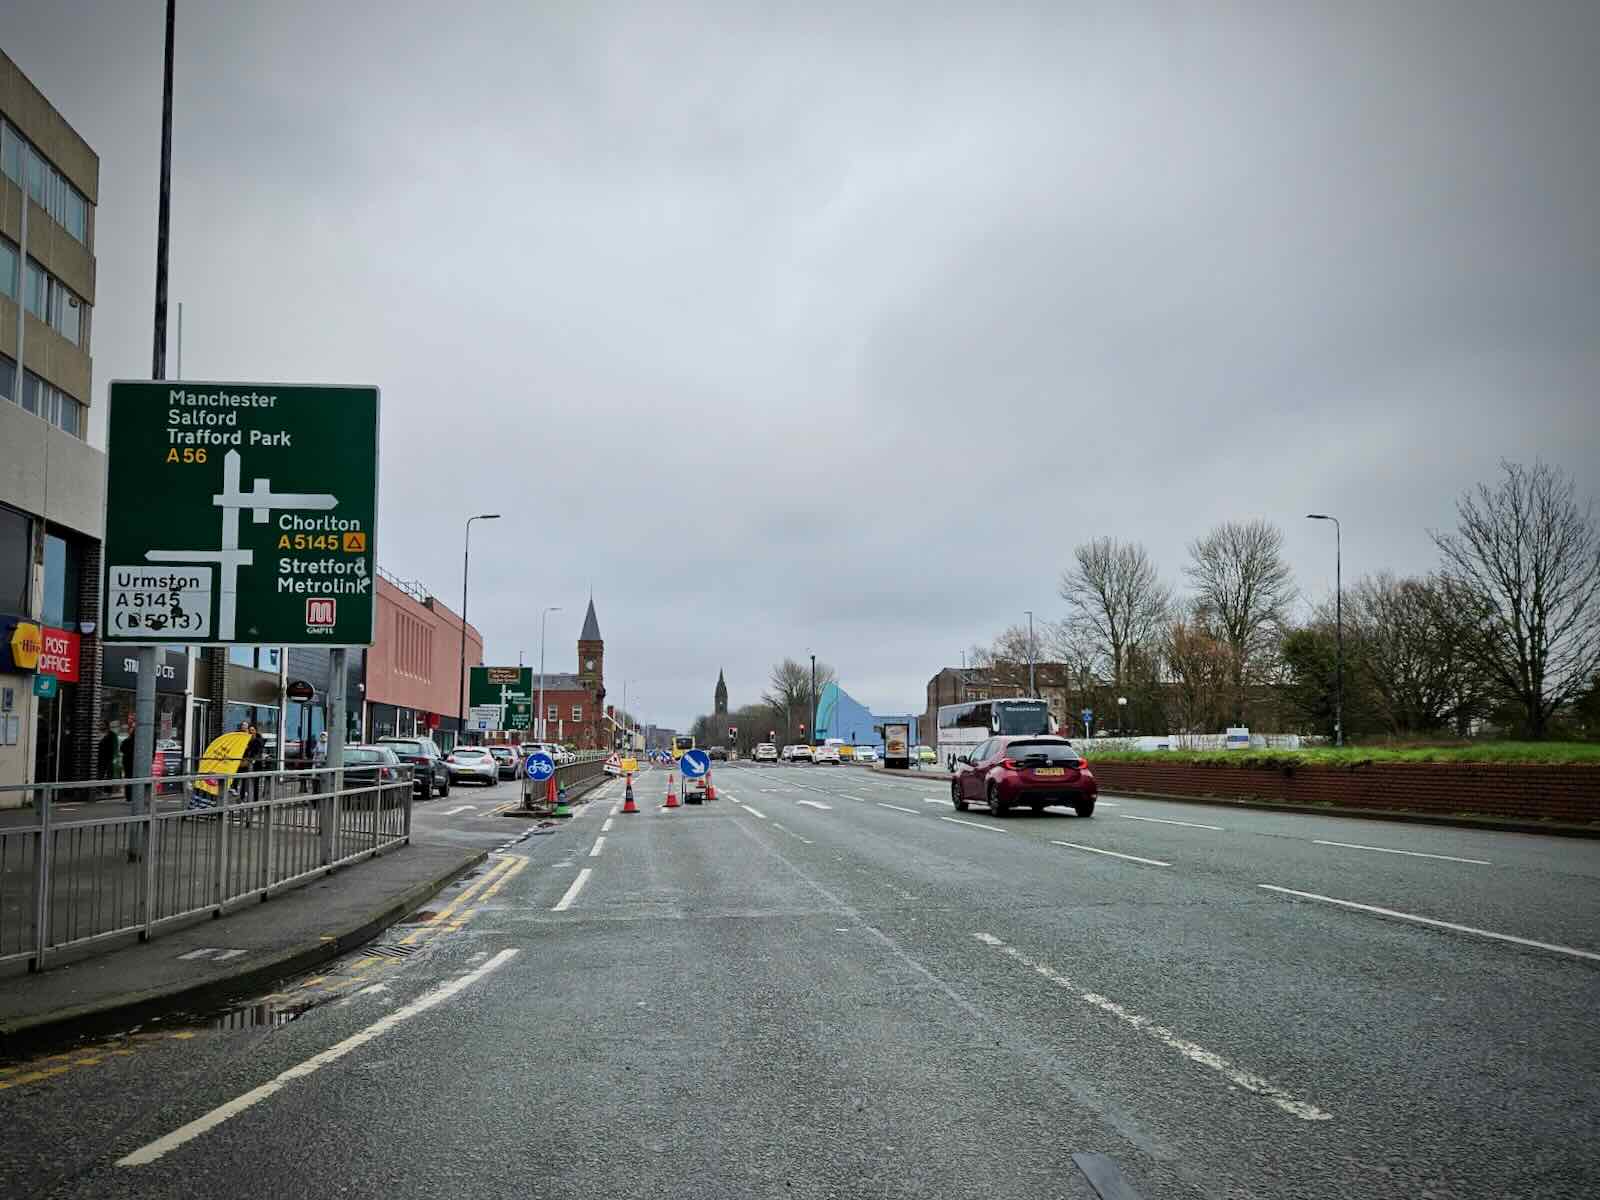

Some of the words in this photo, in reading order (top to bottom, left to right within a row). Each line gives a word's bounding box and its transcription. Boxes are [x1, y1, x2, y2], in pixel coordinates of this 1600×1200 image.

[169, 390, 278, 408] Manchester
[168, 409, 238, 426] Salford
[167, 428, 242, 446] Trafford
[249, 430, 292, 447] Park
[278, 514, 361, 531] Chorlton
[278, 557, 366, 575] Stretford
[117, 573, 200, 589] Urmston
[278, 577, 368, 594] Metrolink
[45, 637, 71, 656] POST
[39, 654, 72, 673] OFFICE
